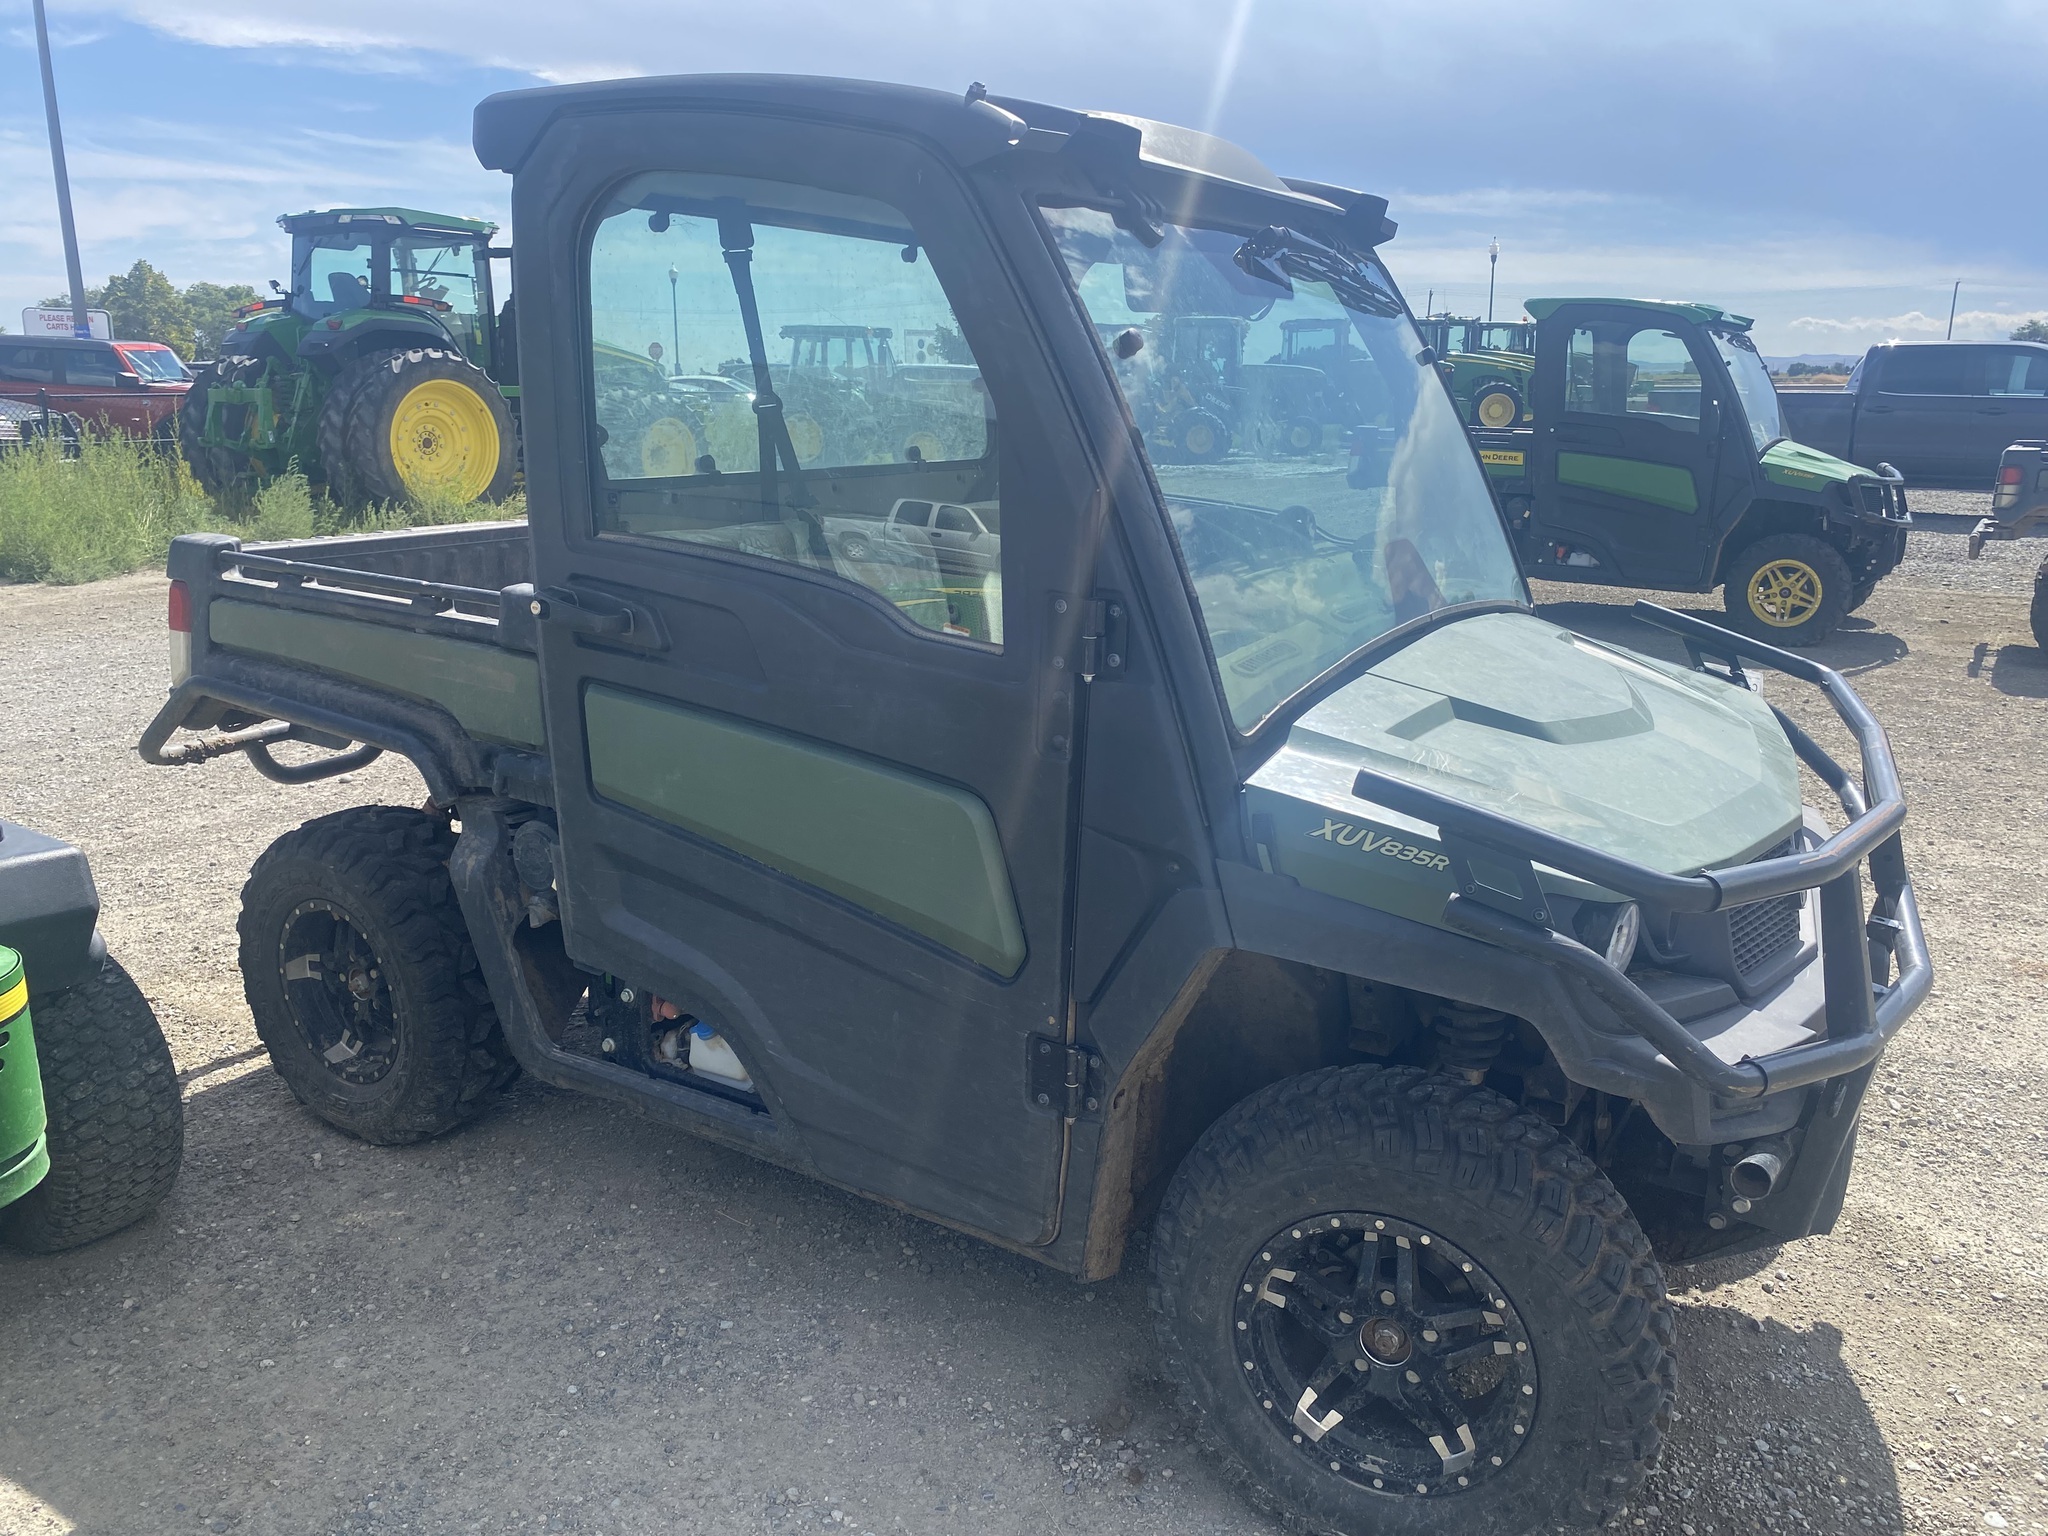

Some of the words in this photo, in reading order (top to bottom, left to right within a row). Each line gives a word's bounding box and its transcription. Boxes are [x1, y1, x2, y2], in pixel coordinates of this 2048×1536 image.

[39, 314, 65, 322] PLEASE
[46, 323, 69, 331] CARTS
[1205, 392, 1231, 411] DEERE
[1492, 453, 1519, 461] DEERE
[1306, 817, 1450, 872] XUV835R
